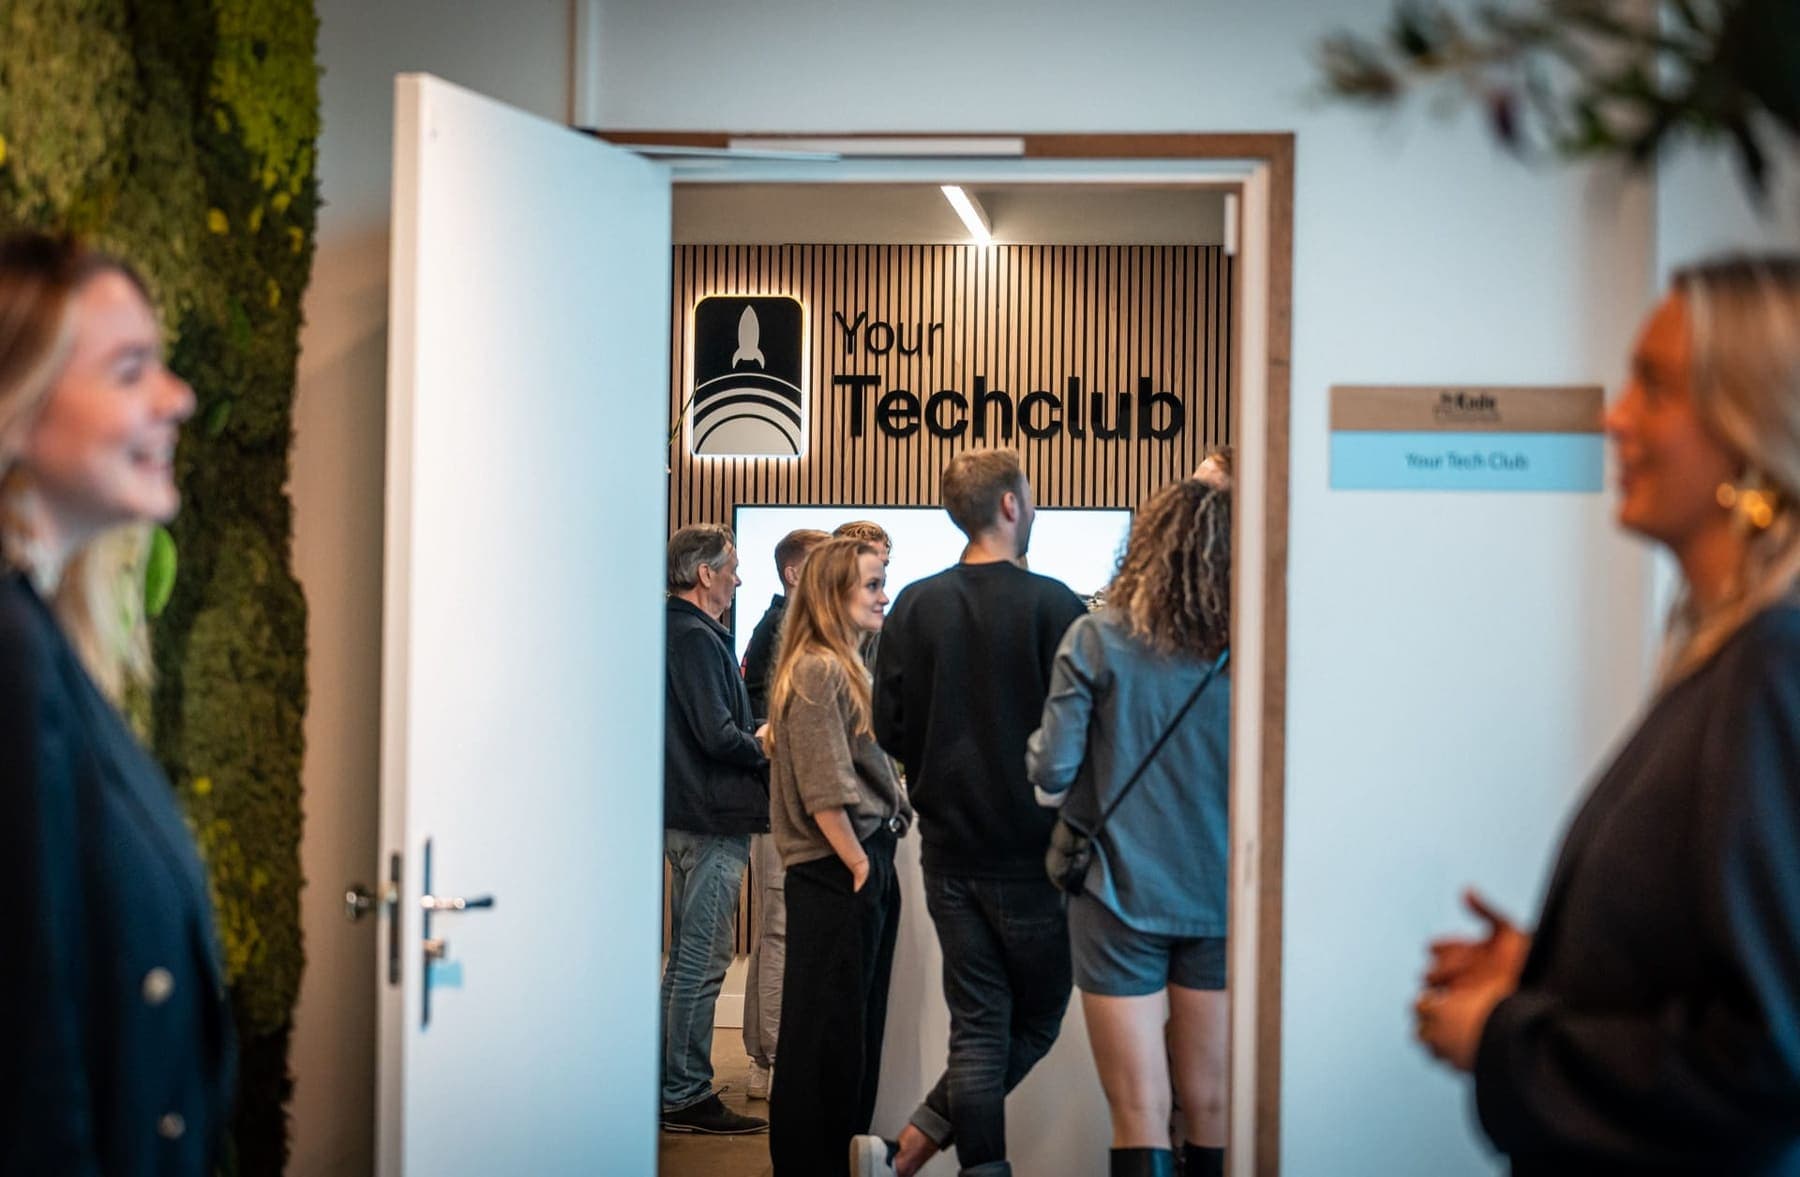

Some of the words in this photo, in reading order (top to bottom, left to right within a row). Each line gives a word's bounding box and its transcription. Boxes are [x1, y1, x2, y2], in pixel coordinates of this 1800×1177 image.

[833, 311, 943, 356] Your
[833, 375, 1184, 440] Techclub
[1405, 452, 1441, 470] Your
[1446, 451, 1484, 470] Tech
[1488, 451, 1529, 471] Club
